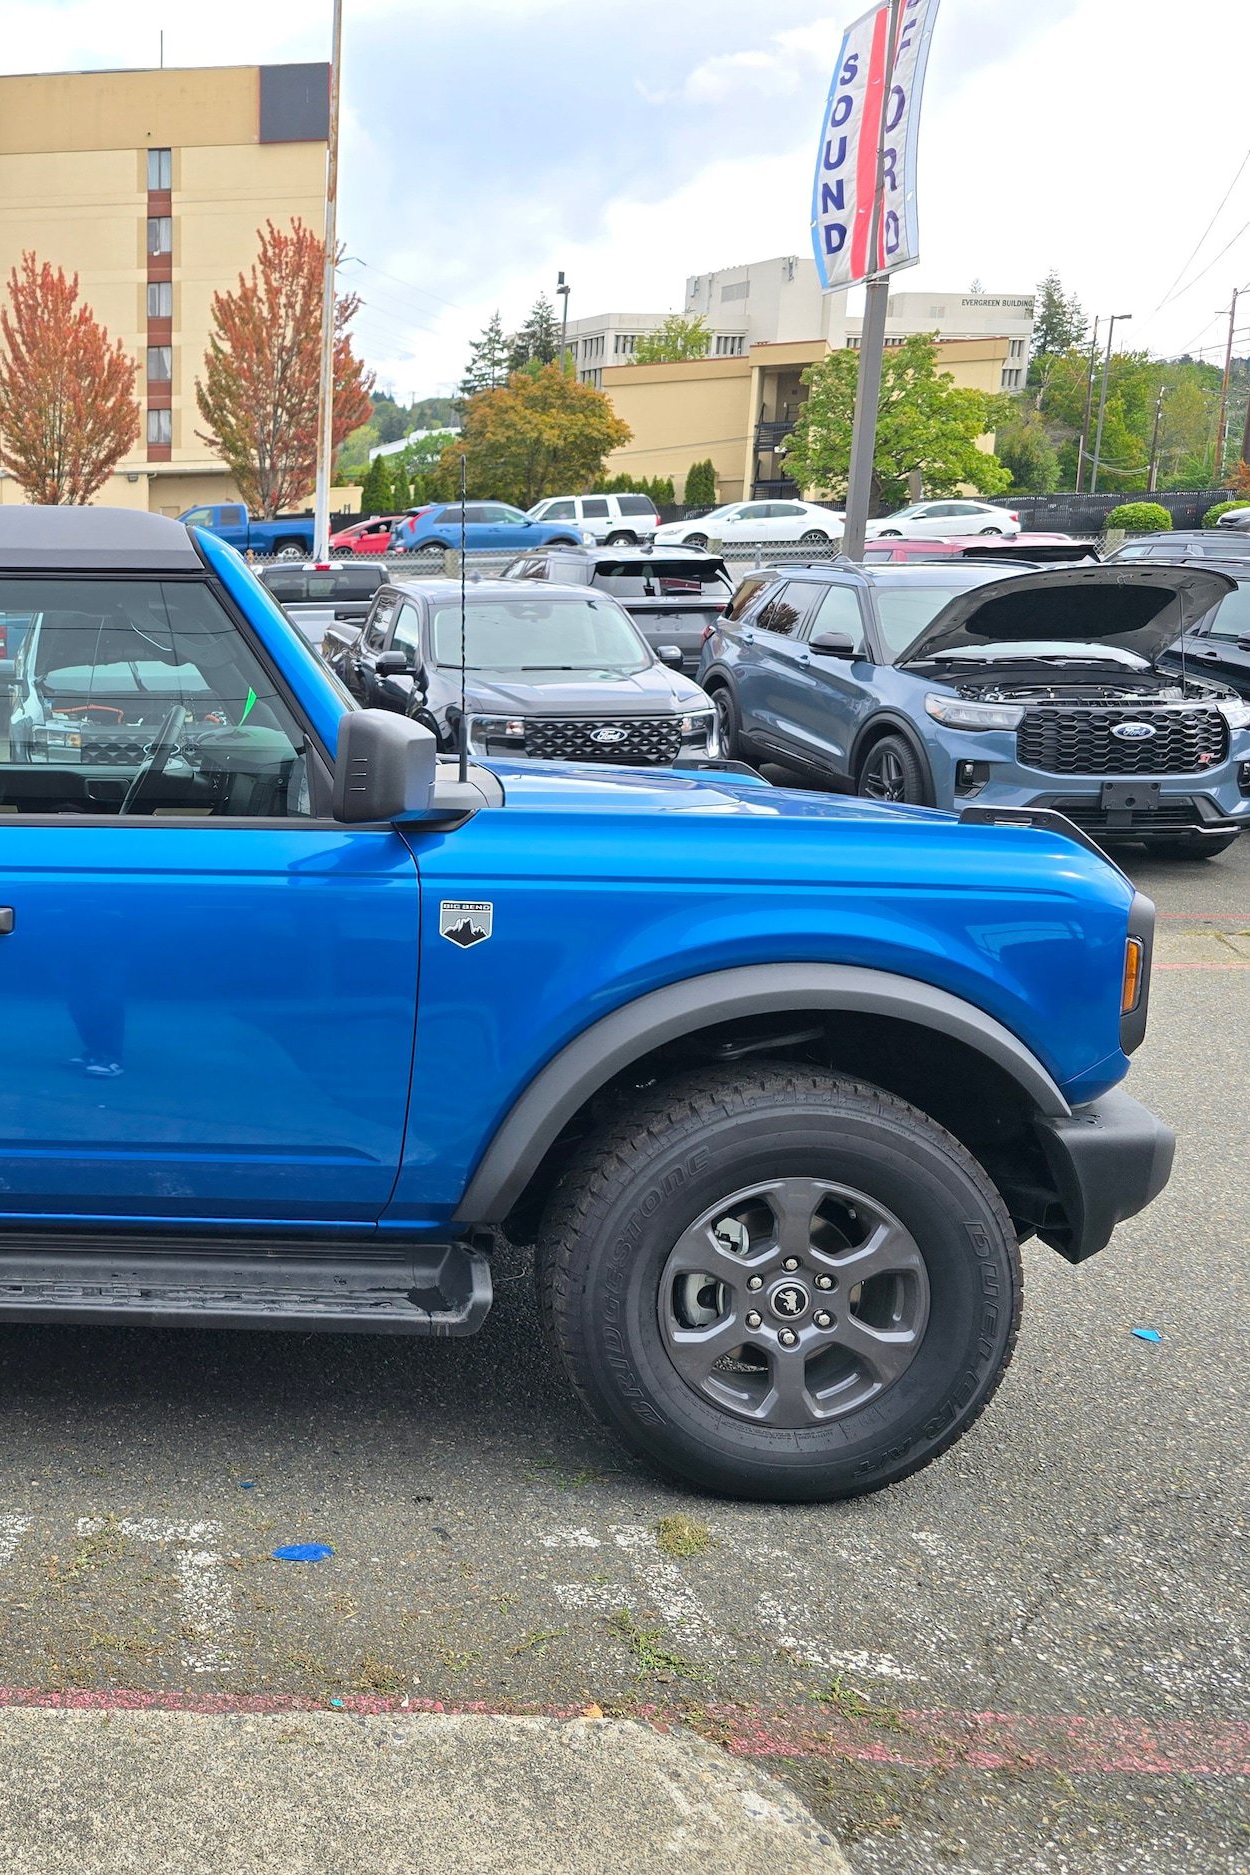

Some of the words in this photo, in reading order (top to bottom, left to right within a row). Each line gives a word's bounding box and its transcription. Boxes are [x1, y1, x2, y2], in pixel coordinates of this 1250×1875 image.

[822, 53, 858, 254] SOUND
[961, 298, 1000, 307] EVERGREEN
[1002, 299, 1033, 307] BUILDING
[604, 1145, 710, 1426] BRIDGESTONE
[922, 1219, 1000, 1440] DUELER
